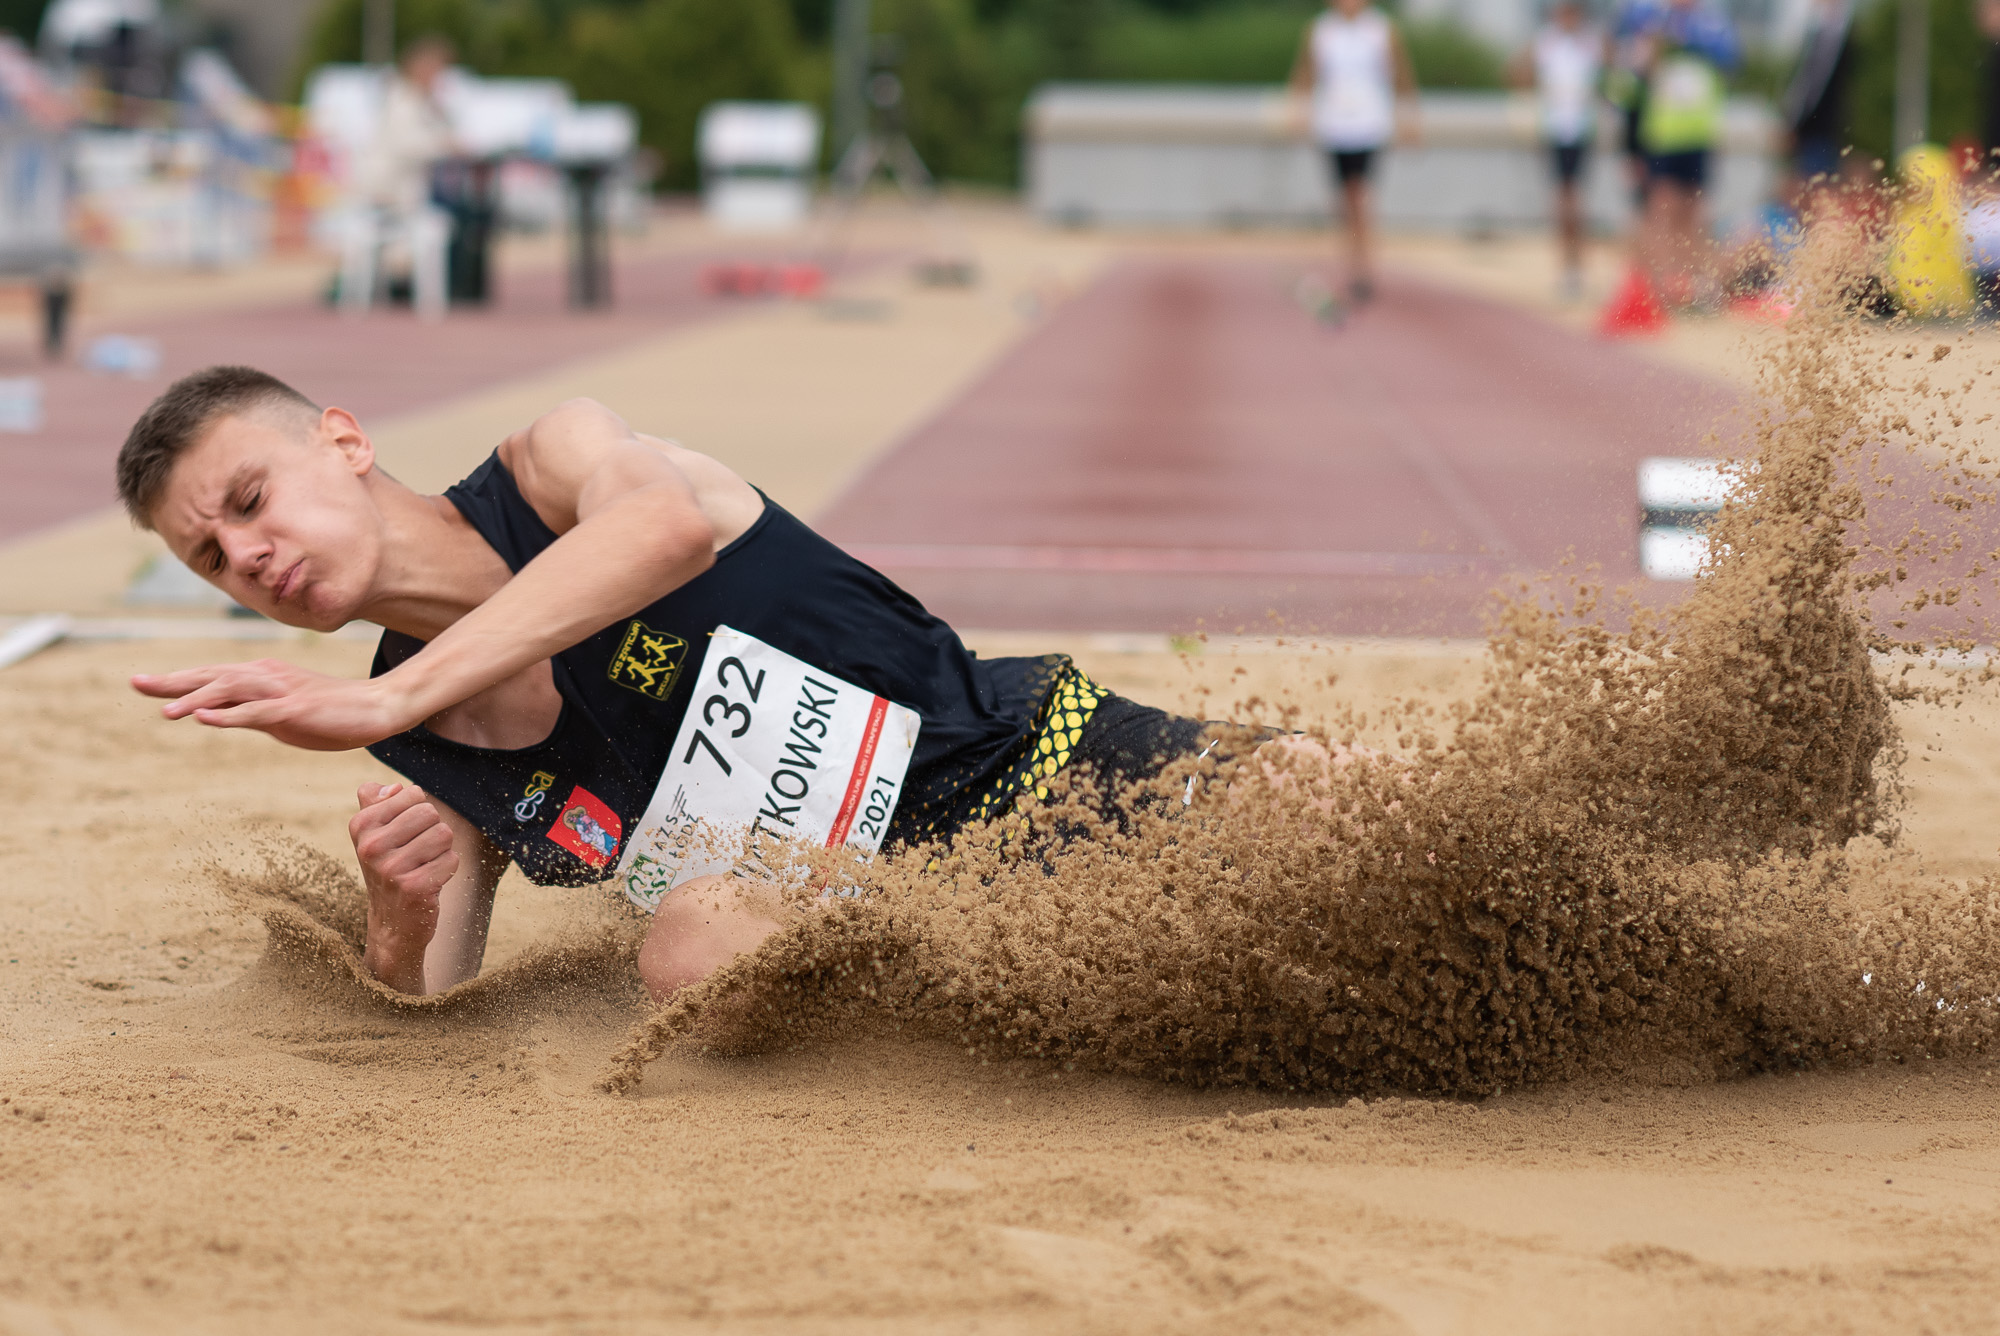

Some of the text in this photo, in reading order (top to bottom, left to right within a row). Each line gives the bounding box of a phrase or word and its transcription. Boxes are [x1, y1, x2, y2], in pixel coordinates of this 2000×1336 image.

[610, 660, 624, 679] LKS
[683, 656, 766, 777] 732
[654, 814, 678, 851] AZS
[859, 776, 895, 840] 2021
